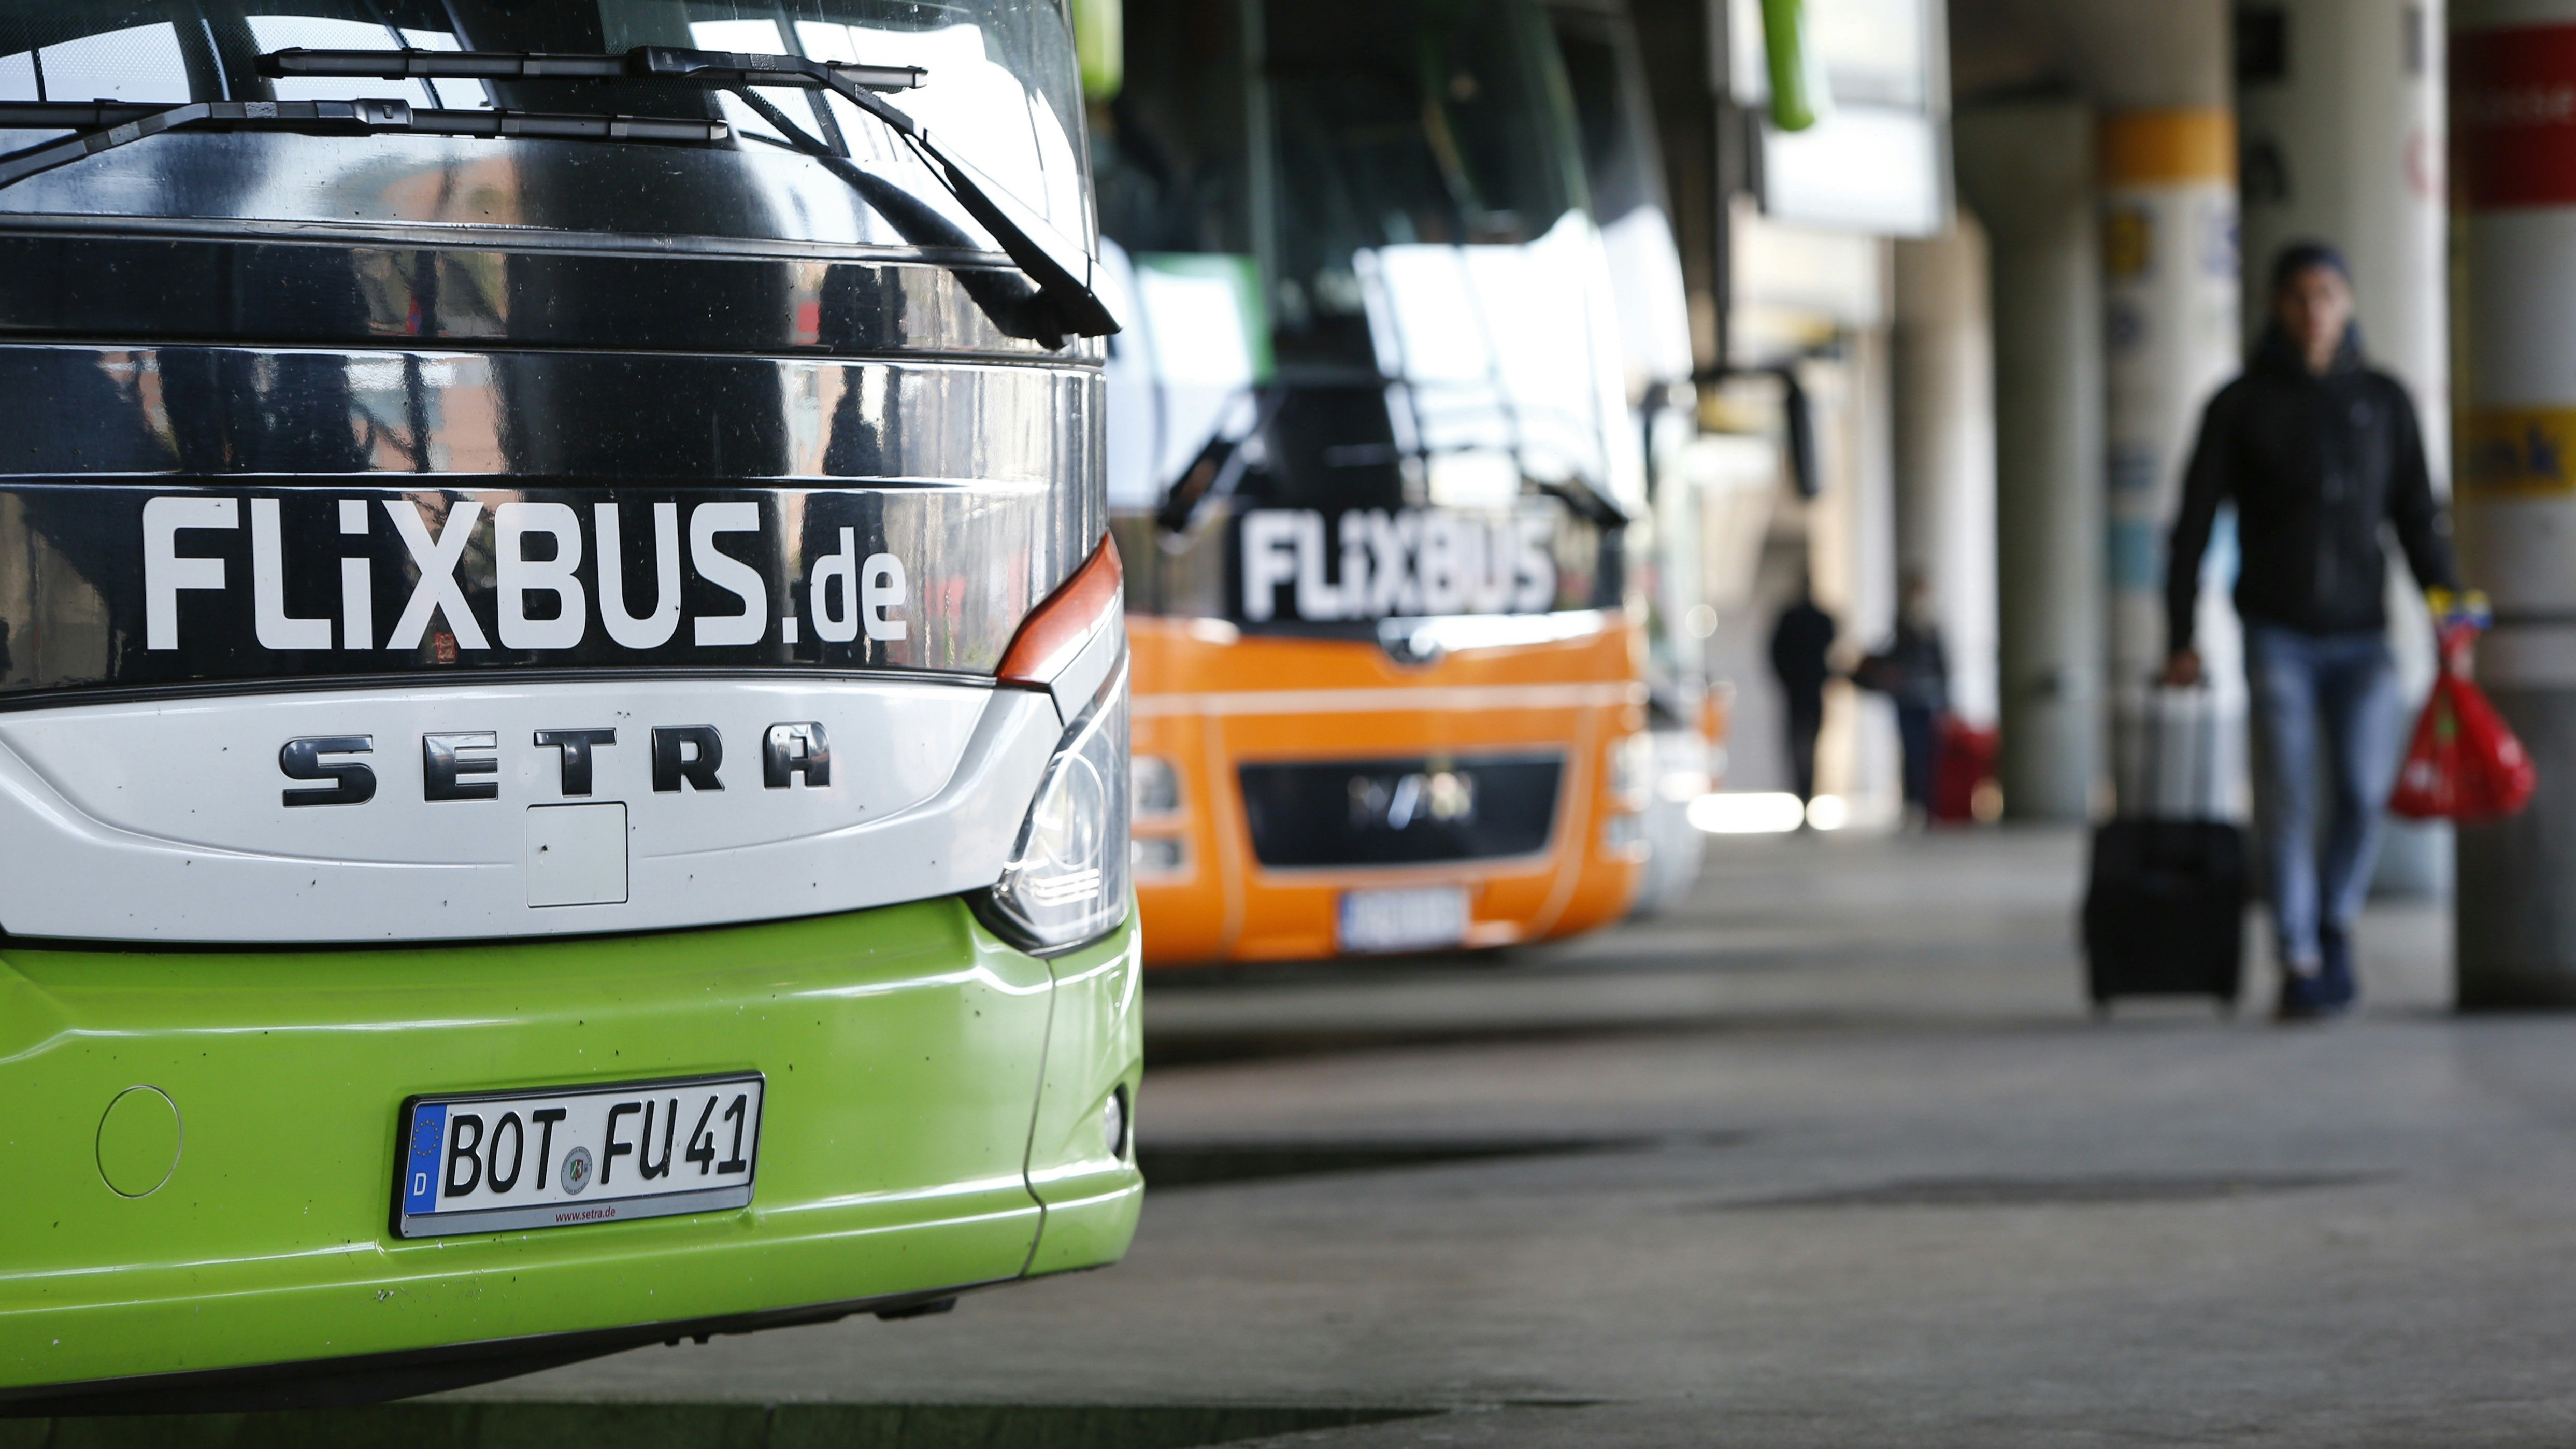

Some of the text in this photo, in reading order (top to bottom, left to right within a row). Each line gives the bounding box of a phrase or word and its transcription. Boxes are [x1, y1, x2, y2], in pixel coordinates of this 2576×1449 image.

[279, 721, 831, 808] SETRA
[444, 1093, 748, 1198] BOT FU 41
[413, 1173, 427, 1196] D
[555, 1206, 616, 1223] www.setra.de
